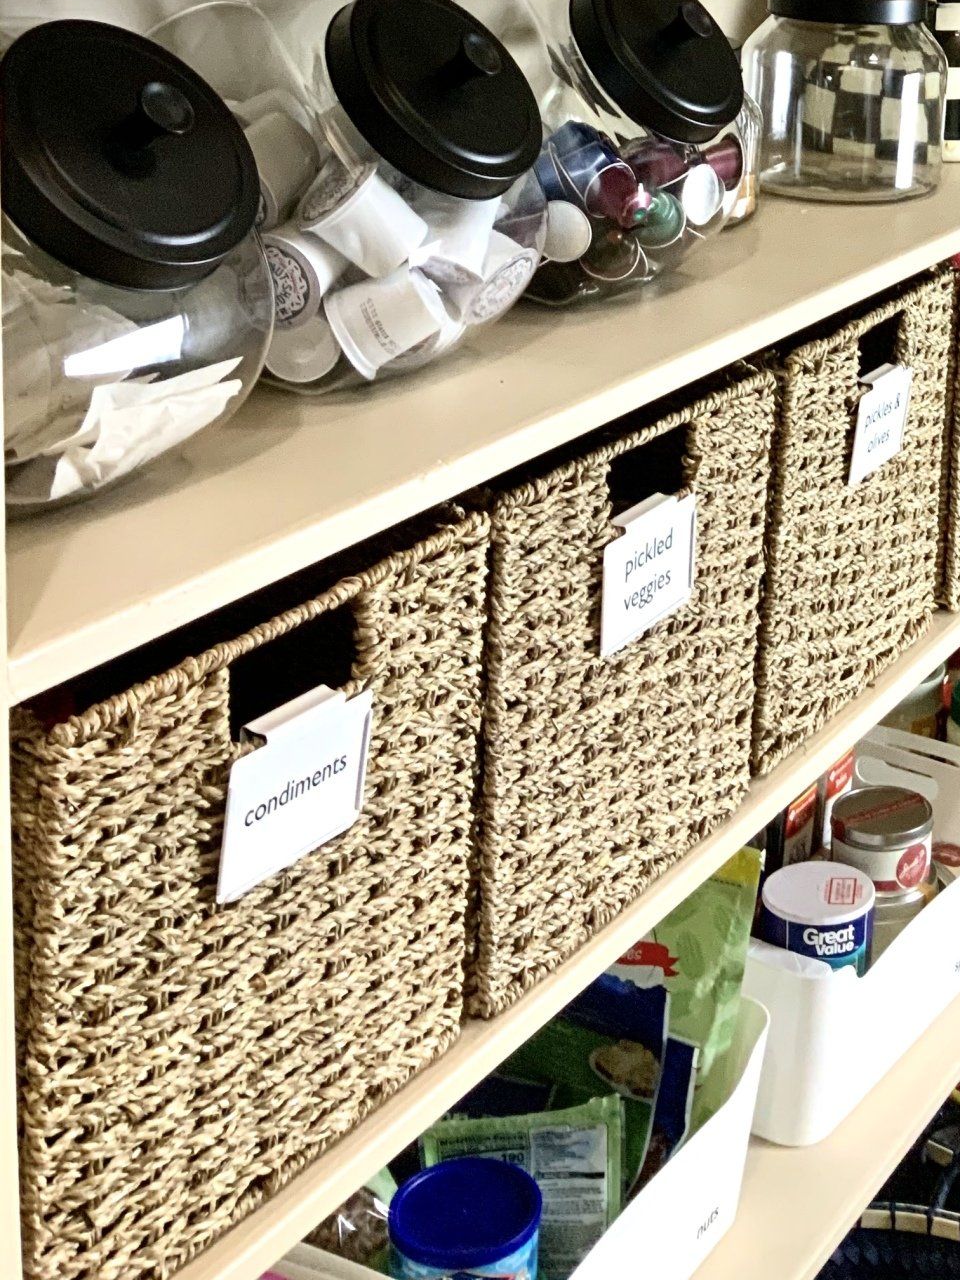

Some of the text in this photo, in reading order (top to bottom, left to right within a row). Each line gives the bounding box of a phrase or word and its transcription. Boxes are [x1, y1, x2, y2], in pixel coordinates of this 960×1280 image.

[863, 392, 901, 433] pickles &
[866, 429, 890, 454] olives
[625, 526, 674, 583] pickled
[623, 570, 672, 610] veggies
[244, 754, 347, 827] condiments
[803, 924, 855, 945] Great
[815, 941, 854, 955] Value
[696, 1206, 719, 1240] nuts
